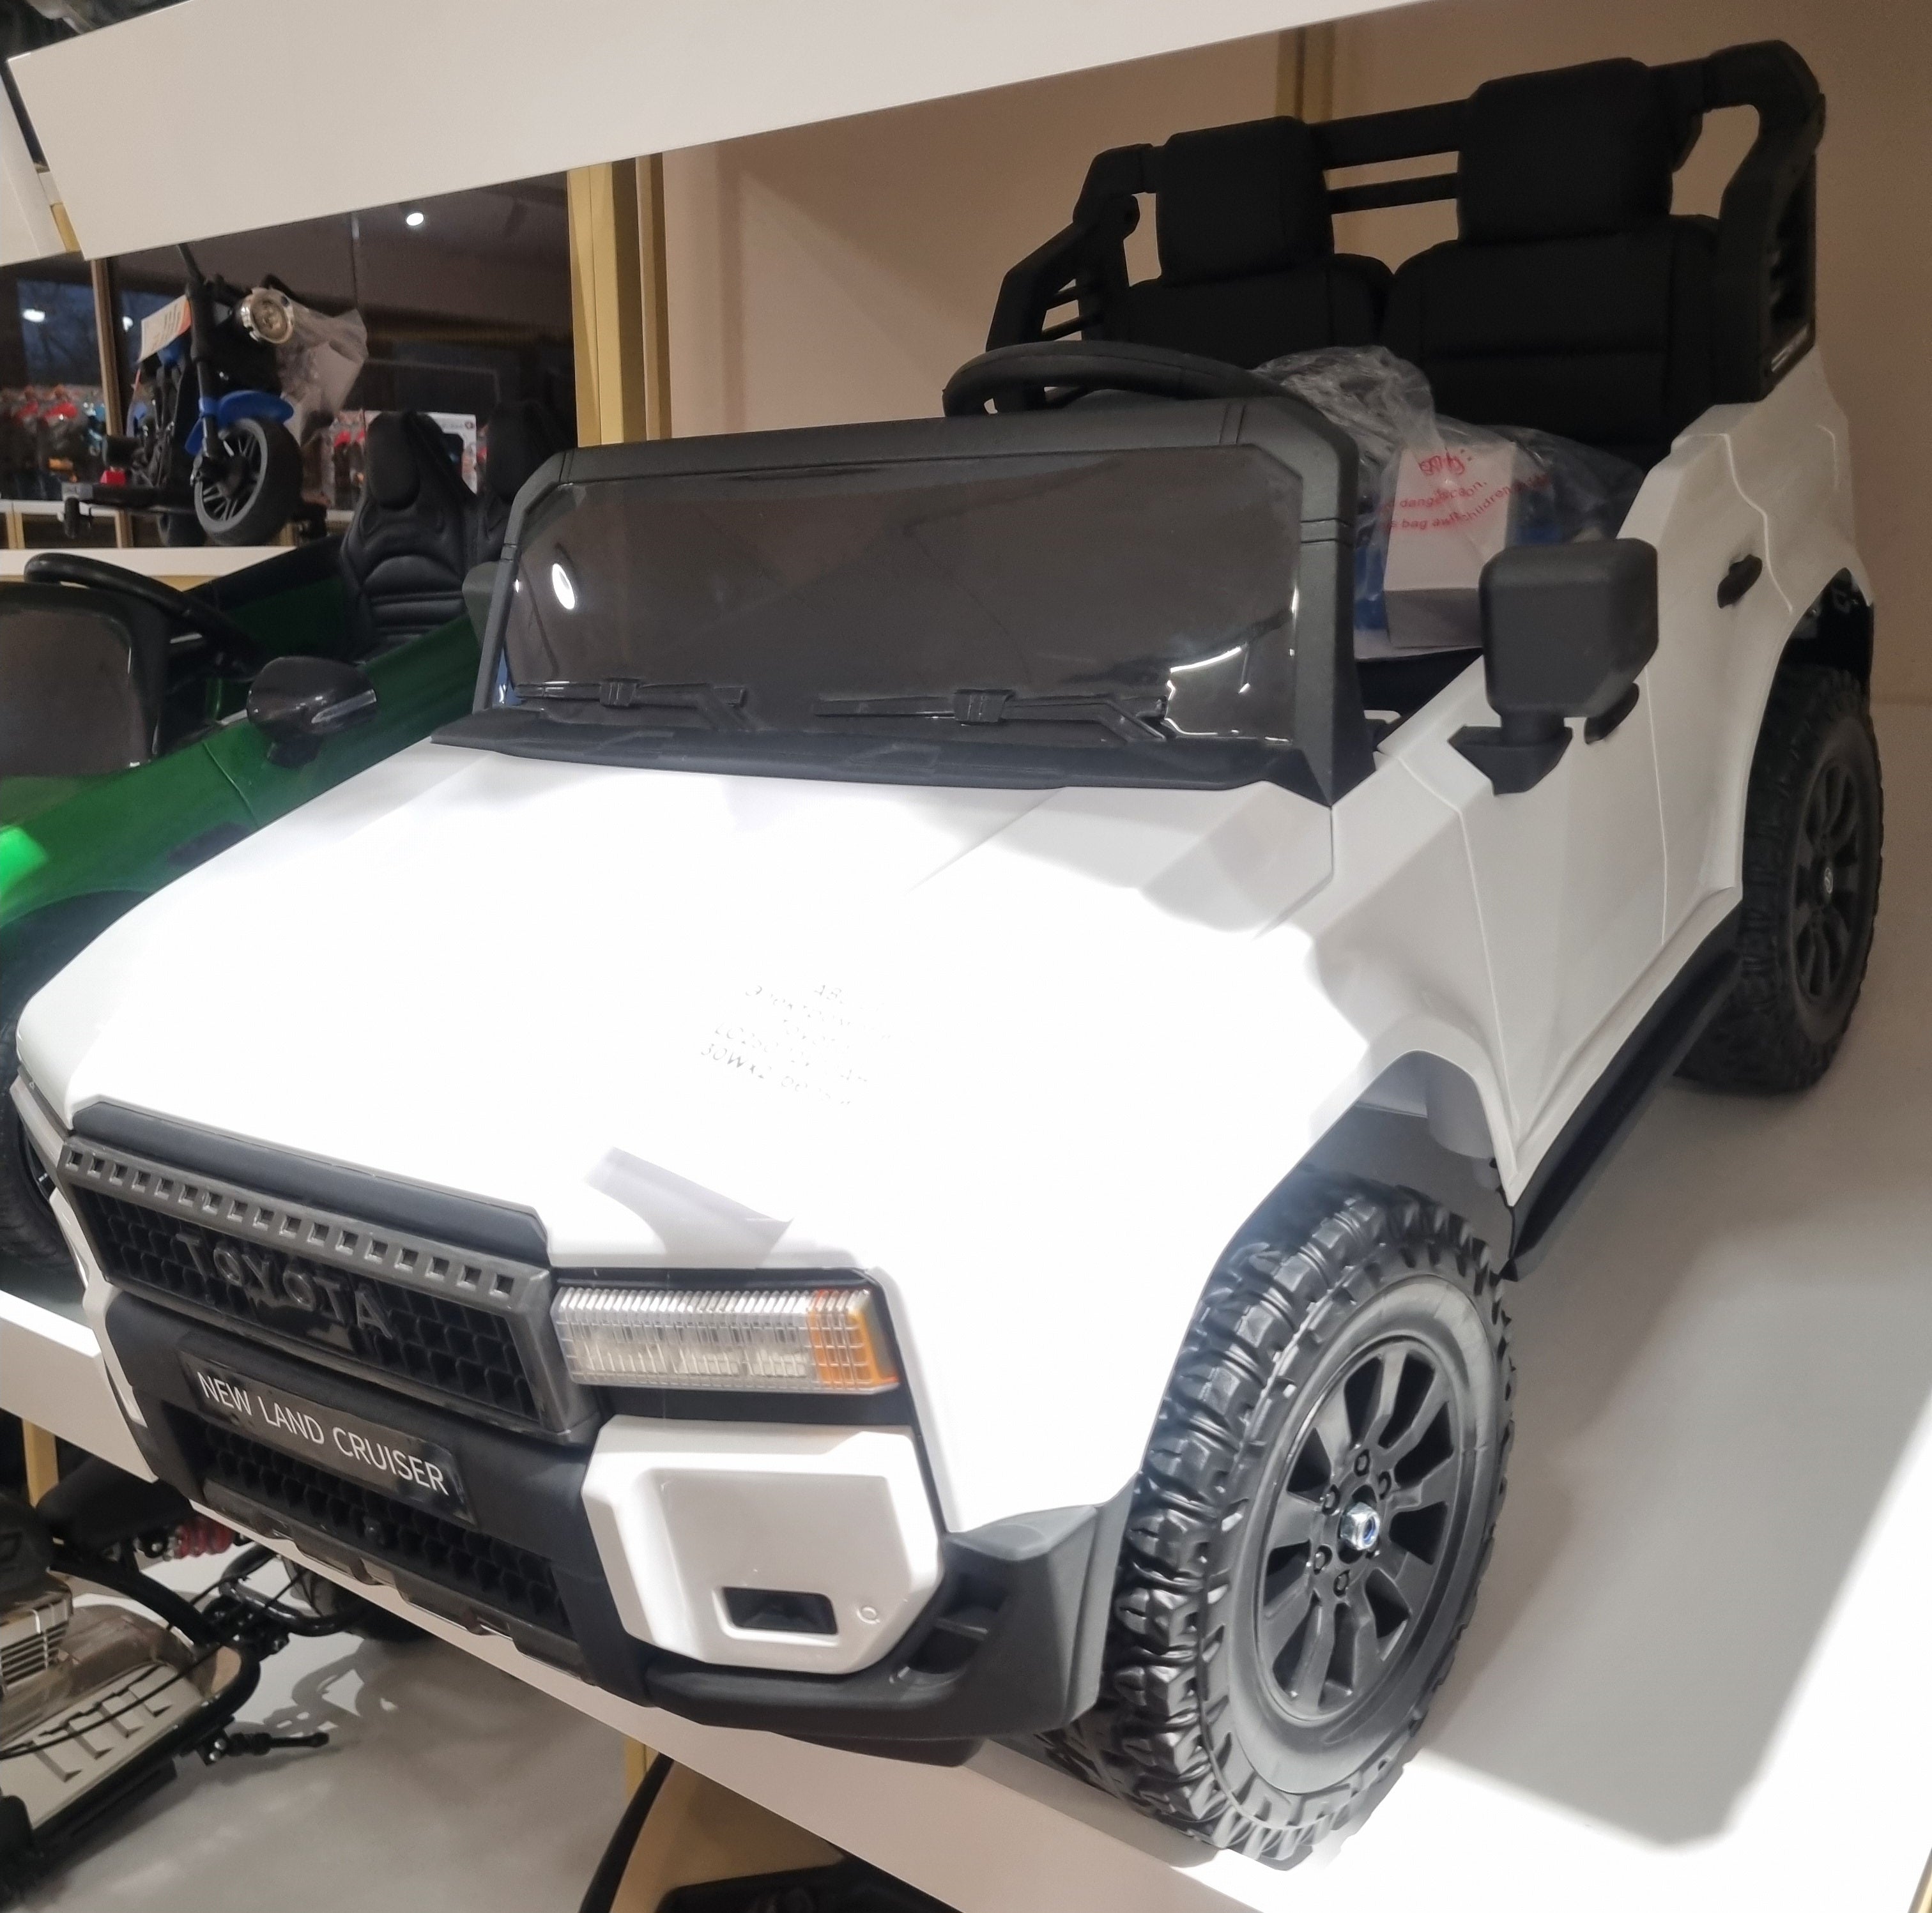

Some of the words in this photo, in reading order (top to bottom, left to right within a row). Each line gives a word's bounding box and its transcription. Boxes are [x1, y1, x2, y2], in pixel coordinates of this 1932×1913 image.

[175, 1232, 393, 1340] TOYOTA
[197, 1371, 253, 1417] NEW
[257, 1395, 325, 1445] LAND
[332, 1426, 449, 1496] CRUISER
